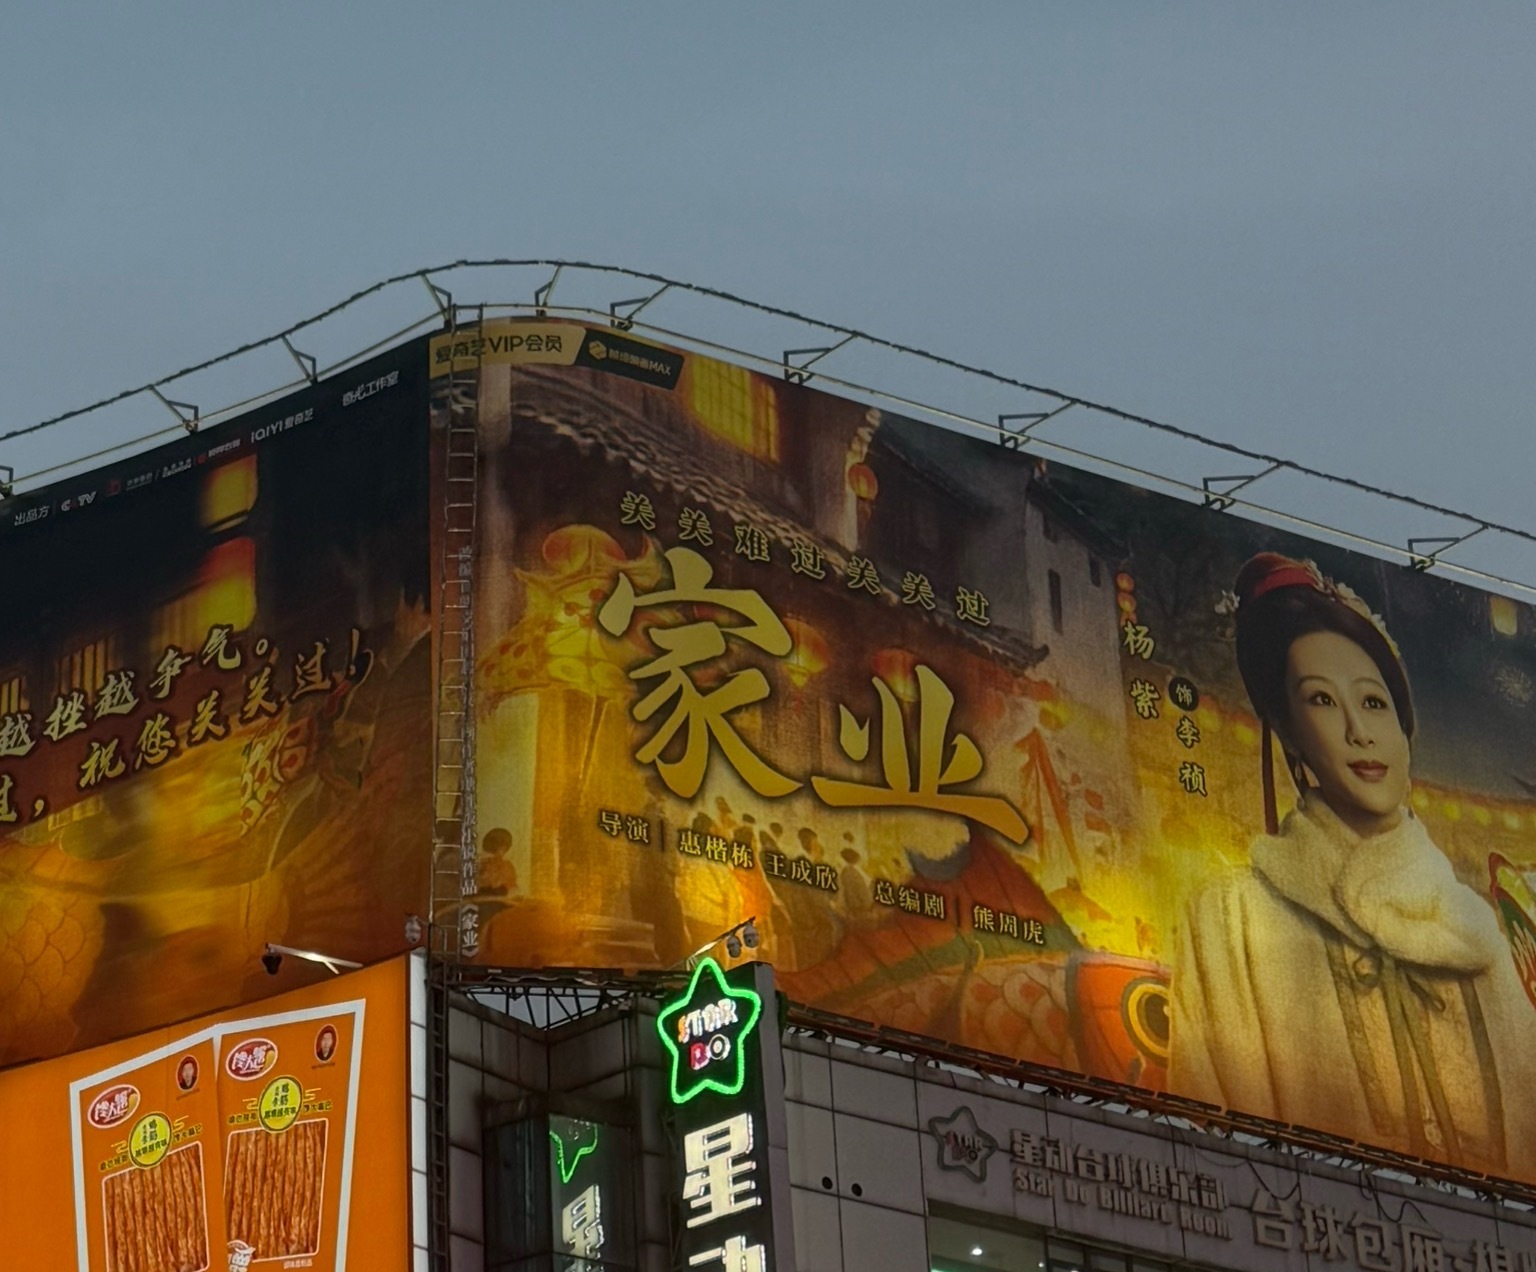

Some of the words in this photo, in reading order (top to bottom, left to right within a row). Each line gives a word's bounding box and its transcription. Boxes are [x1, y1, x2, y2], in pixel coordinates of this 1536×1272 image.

[598, 545, 1030, 846] 家业
[1123, 621, 1161, 720] 杨紫
[600, 811, 650, 844] 导演
[678, 828, 754, 869] 惠楷栋
[765, 854, 838, 891] 王成欣
[874, 882, 946, 920] 总编剧
[973, 905, 1045, 945] 熊周虎
[677, 997, 738, 1044] STAR
[1010, 1128, 1228, 1212] 星动台球俱乐部
